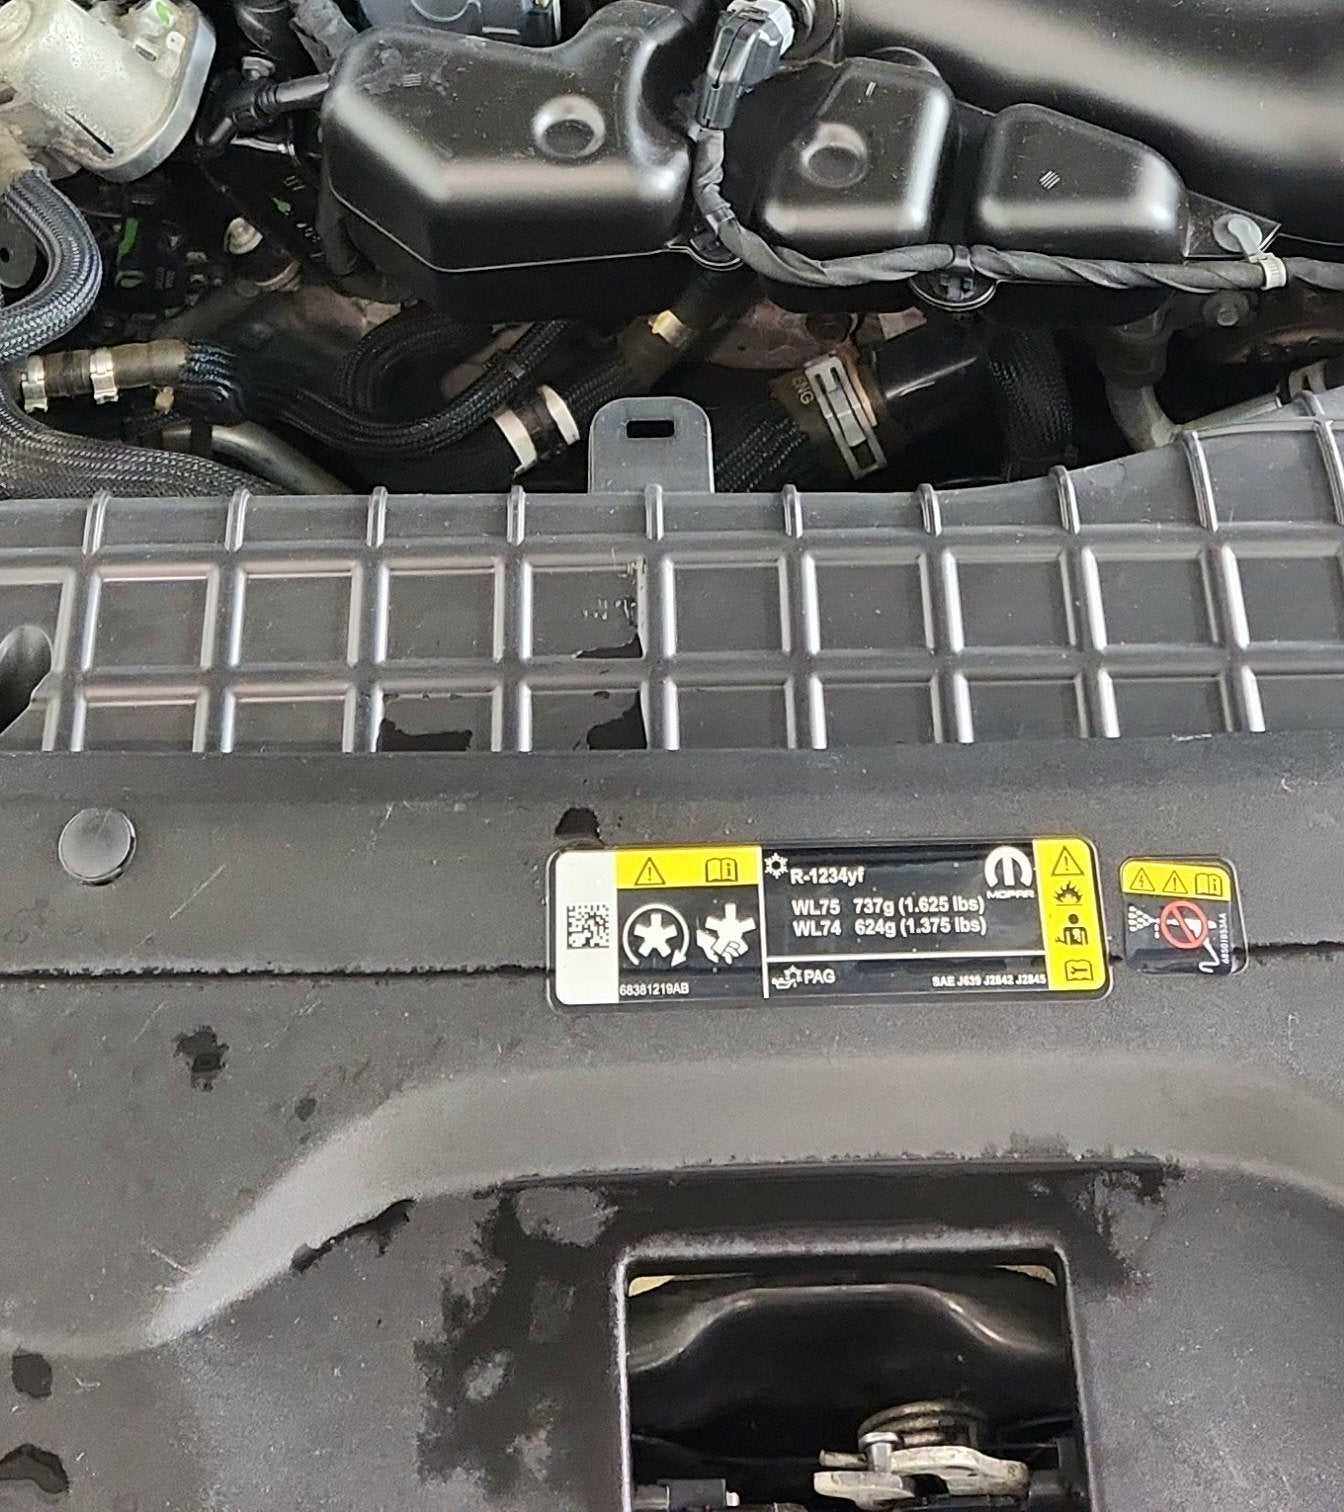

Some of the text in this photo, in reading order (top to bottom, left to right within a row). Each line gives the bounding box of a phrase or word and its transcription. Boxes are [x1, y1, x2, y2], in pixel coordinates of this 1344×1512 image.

[793, 376, 814, 406] ENG
[790, 866, 865, 887] R-1234yf
[986, 890, 1035, 899] MOPAR
[792, 895, 985, 917] WL75 737g (1.625 lbs)
[793, 916, 987, 938] WL74 624g (1.375 lbs)
[804, 969, 836, 985] PAG
[932, 974, 1046, 987] SAE J639 J2842 J2845
[619, 983, 690, 996] 68381219AB
